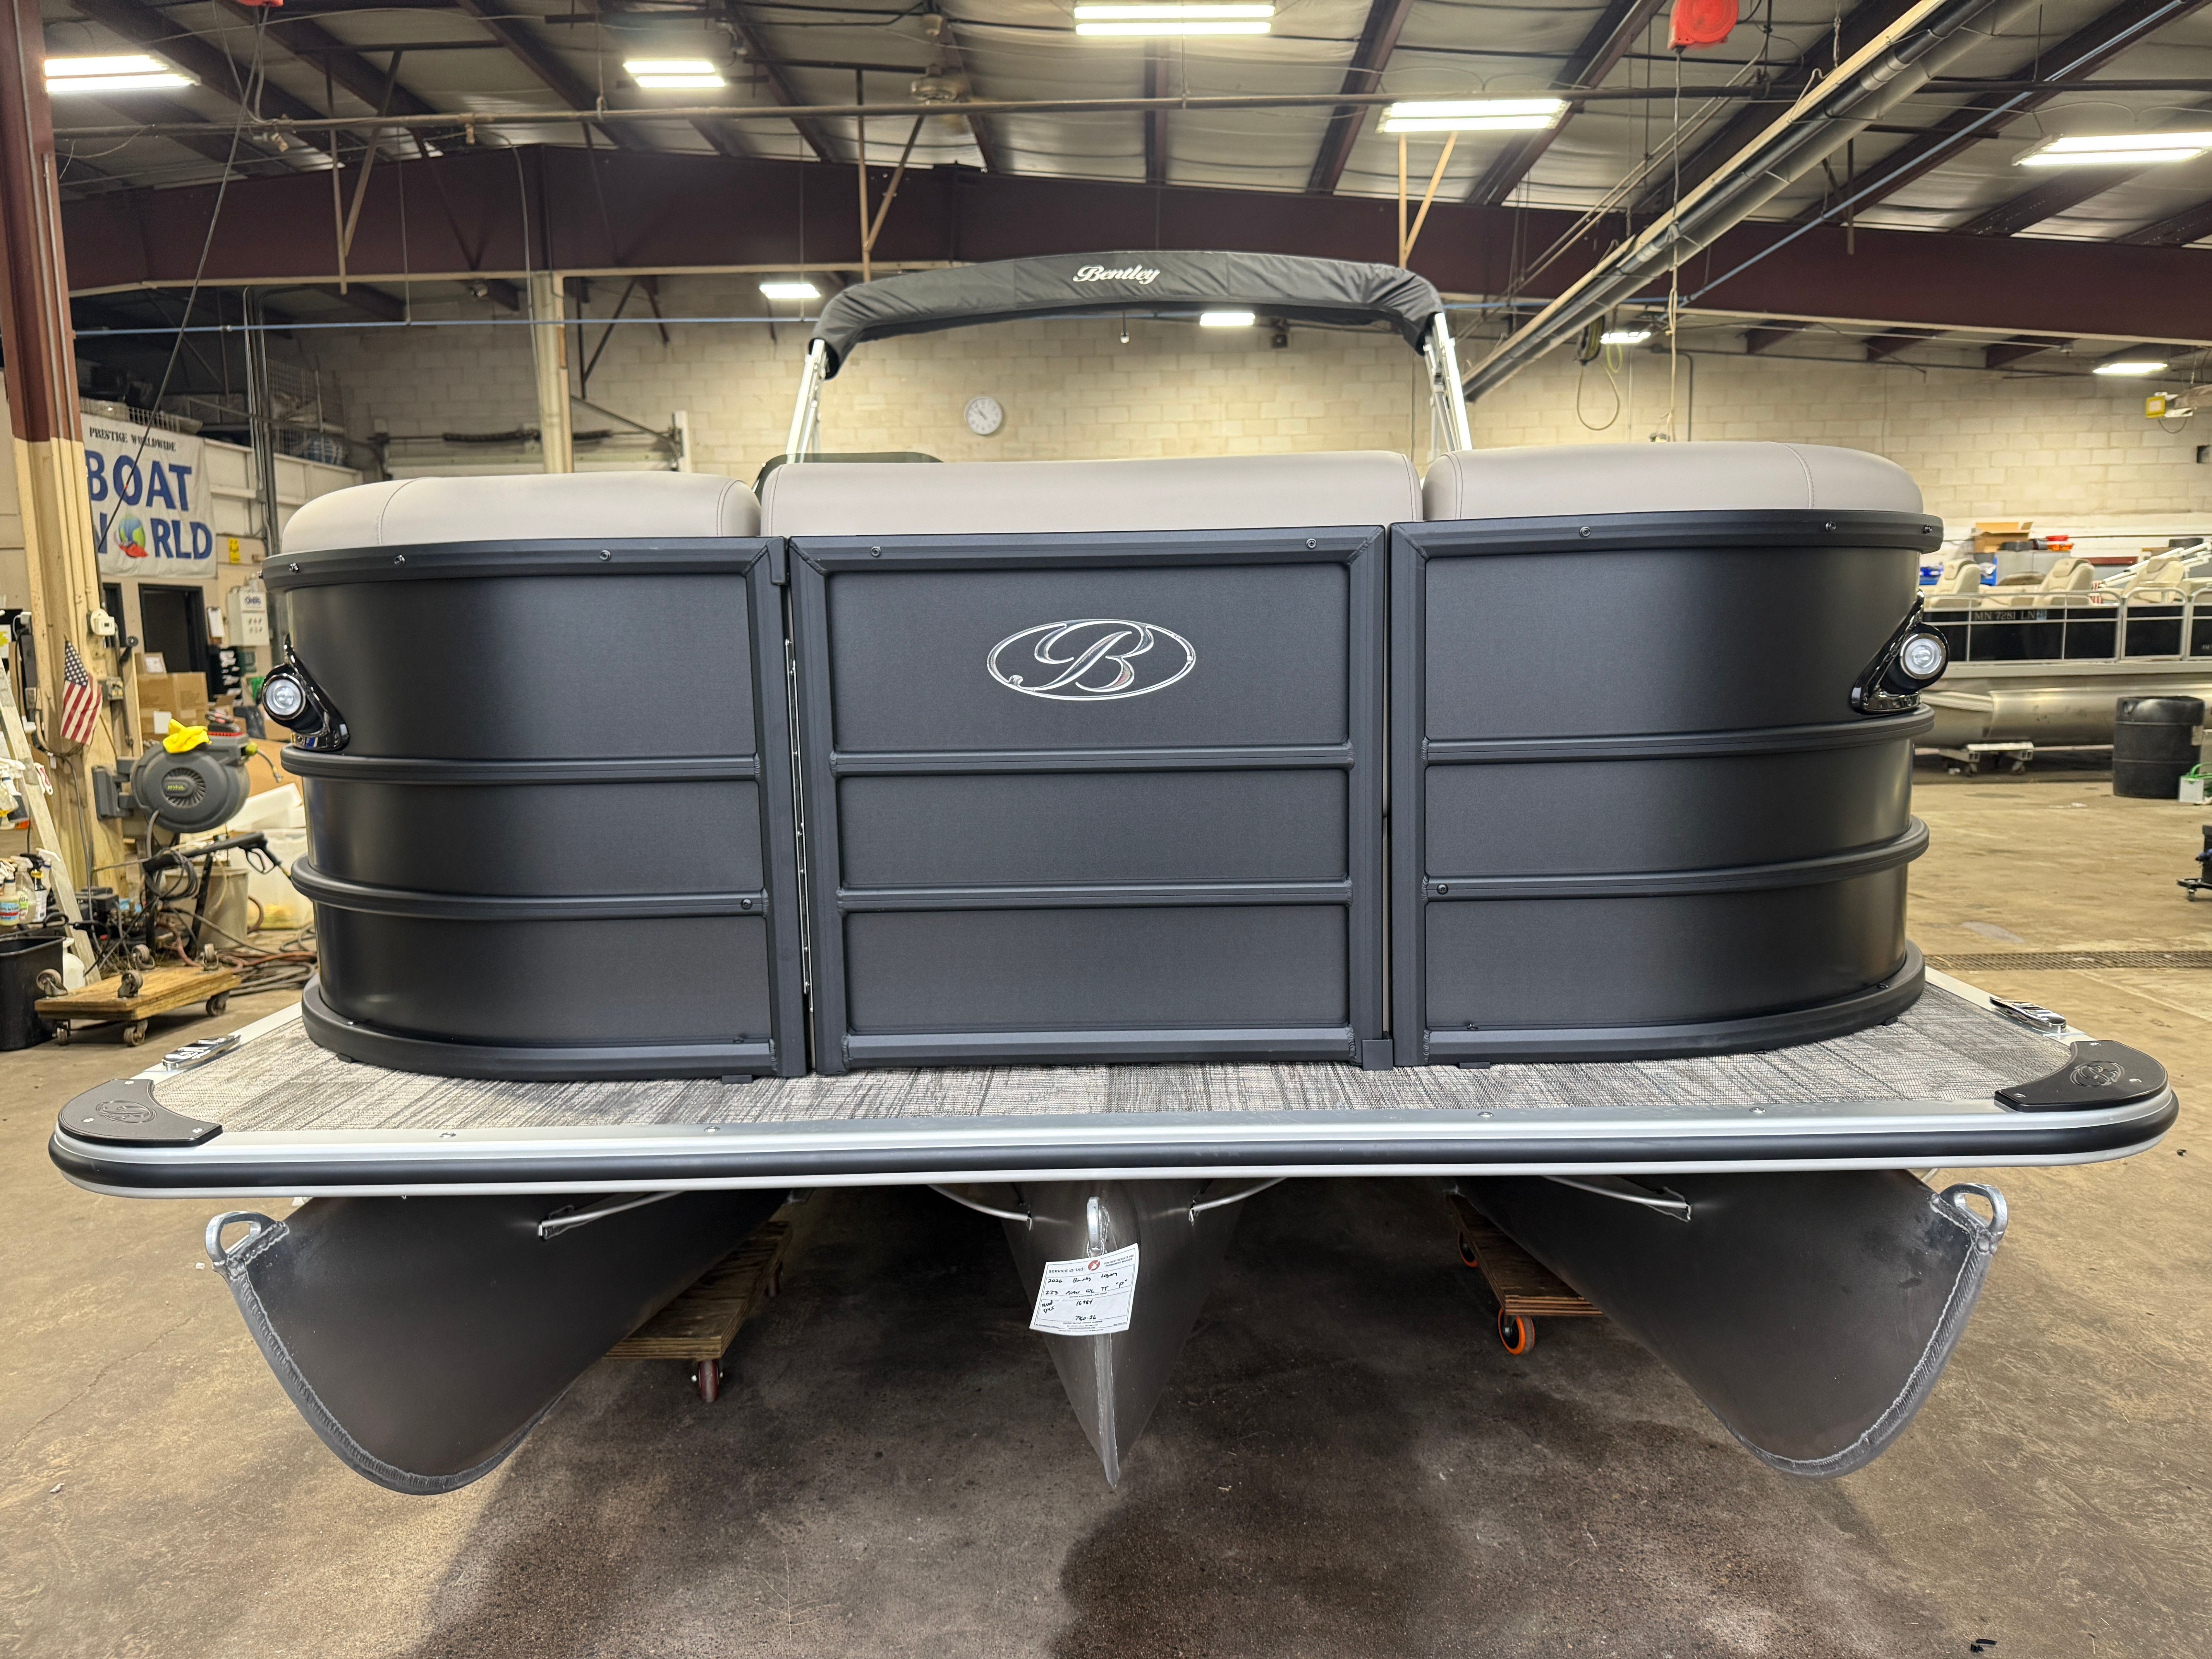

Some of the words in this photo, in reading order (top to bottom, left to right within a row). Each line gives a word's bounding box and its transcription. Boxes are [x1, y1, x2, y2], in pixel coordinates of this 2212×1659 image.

[1073, 264, 1160, 285] Bentley
[89, 426, 128, 443] PRESTIGE
[131, 434, 176, 452] WORLDWIDE
[85, 450, 192, 511] BOAT
[1975, 611, 1992, 620] MN
[1008, 619, 1154, 692] B
